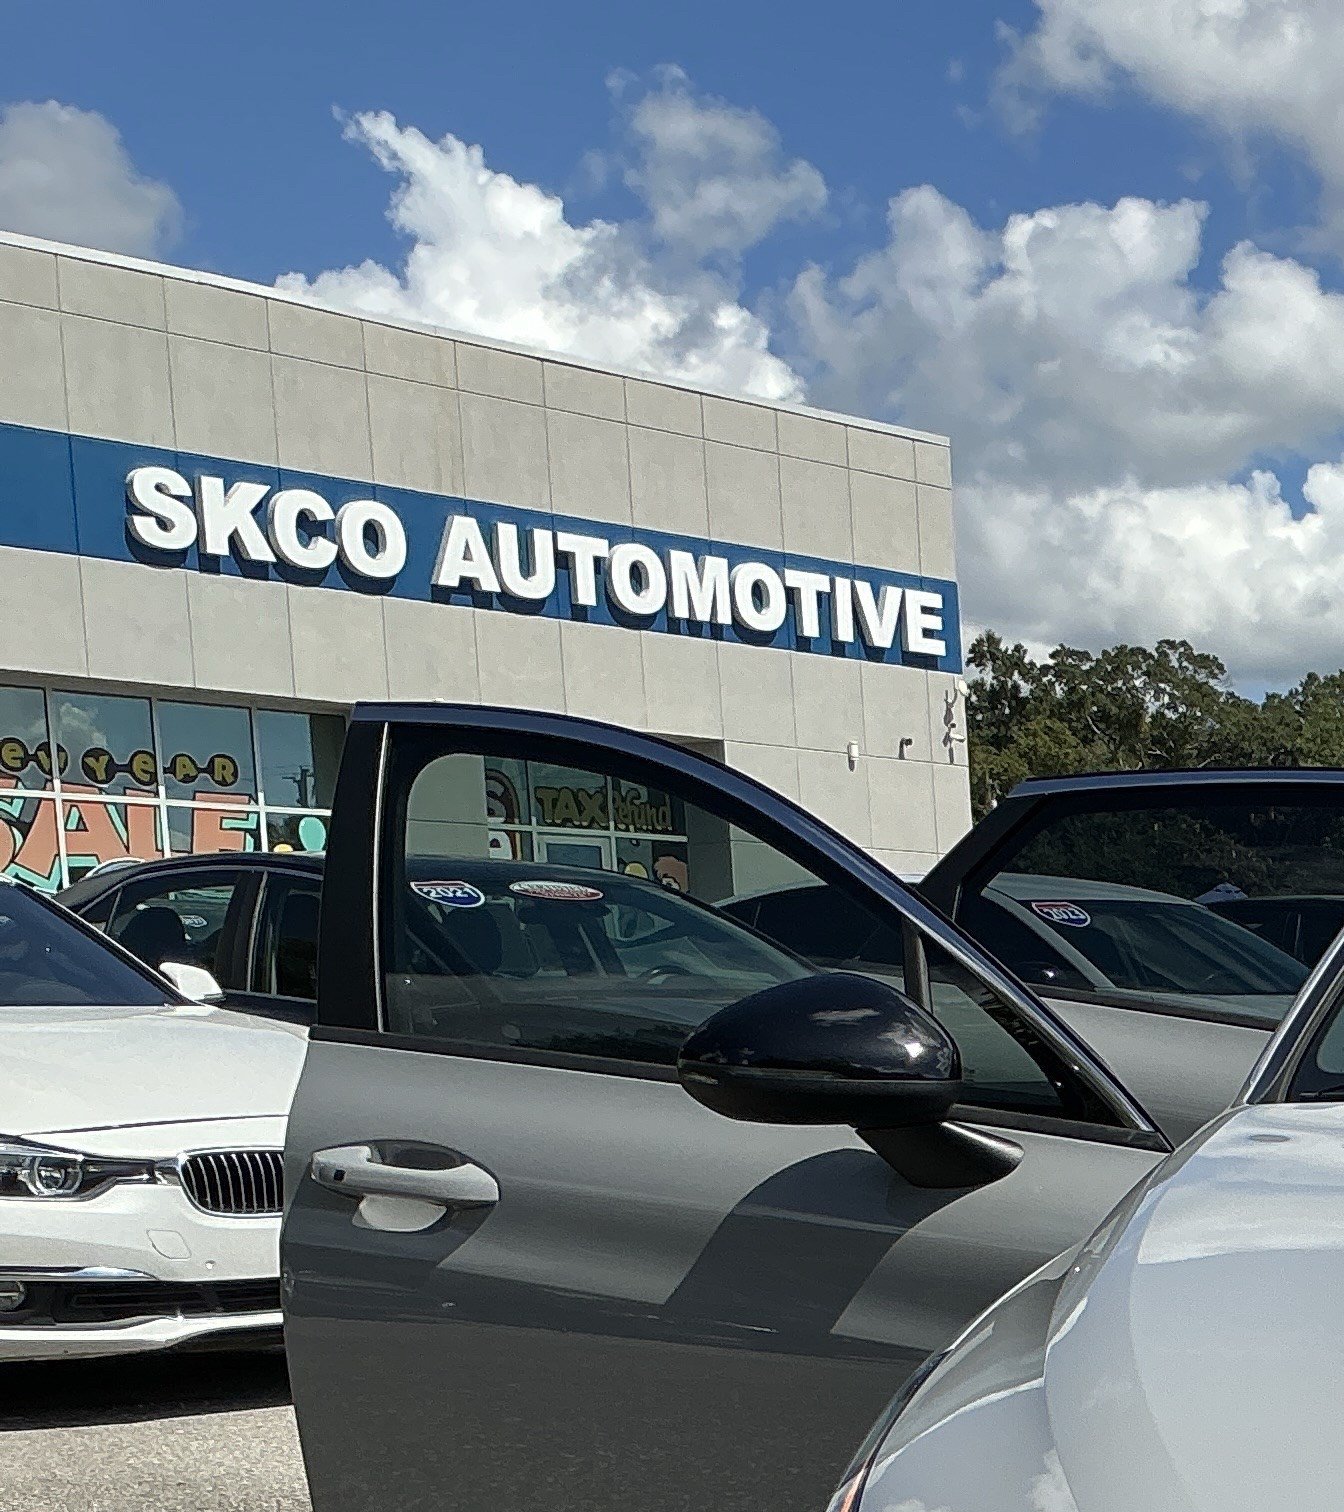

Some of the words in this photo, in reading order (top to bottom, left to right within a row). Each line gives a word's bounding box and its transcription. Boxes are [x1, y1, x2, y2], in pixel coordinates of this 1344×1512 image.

[125, 466, 407, 579] SKCO
[430, 514, 947, 657] AUTOMOTIVE
[534, 786, 612, 829] TAX
[422, 887, 477, 898] 2021
